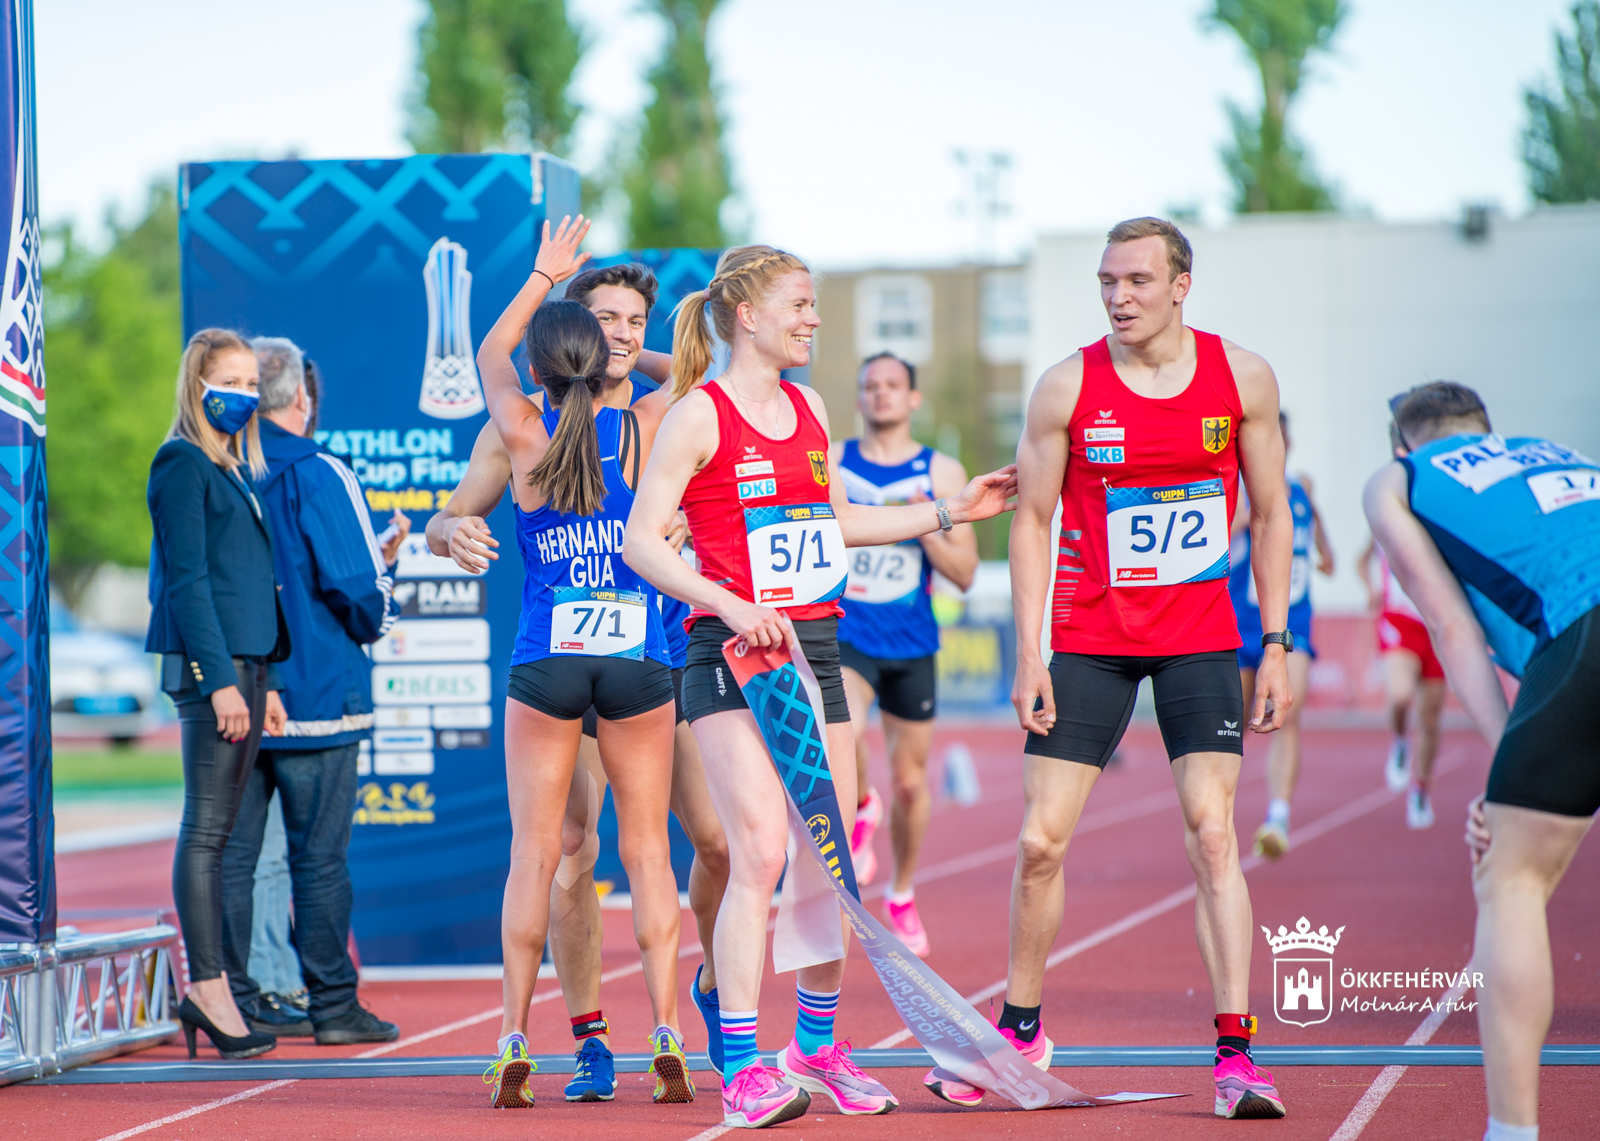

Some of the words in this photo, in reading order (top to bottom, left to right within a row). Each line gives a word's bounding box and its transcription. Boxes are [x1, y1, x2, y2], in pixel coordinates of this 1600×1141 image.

[1086, 447, 1124, 463] DKB
[352, 457, 407, 490] Cup
[739, 479, 776, 498] DKB
[1161, 489, 1184, 498] UIPM
[791, 507, 811, 517] UIPM
[1130, 509, 1208, 554] 5/2
[770, 529, 832, 573] 5/1
[570, 555, 615, 588] GUA
[853, 549, 905, 581] 8/2
[417, 580, 481, 606] RAM
[573, 607, 626, 638] 7/1
[408, 673, 477, 696] BÉRES
[715, 666, 726, 690] CRAFT
[1217, 729, 1241, 738] erima
